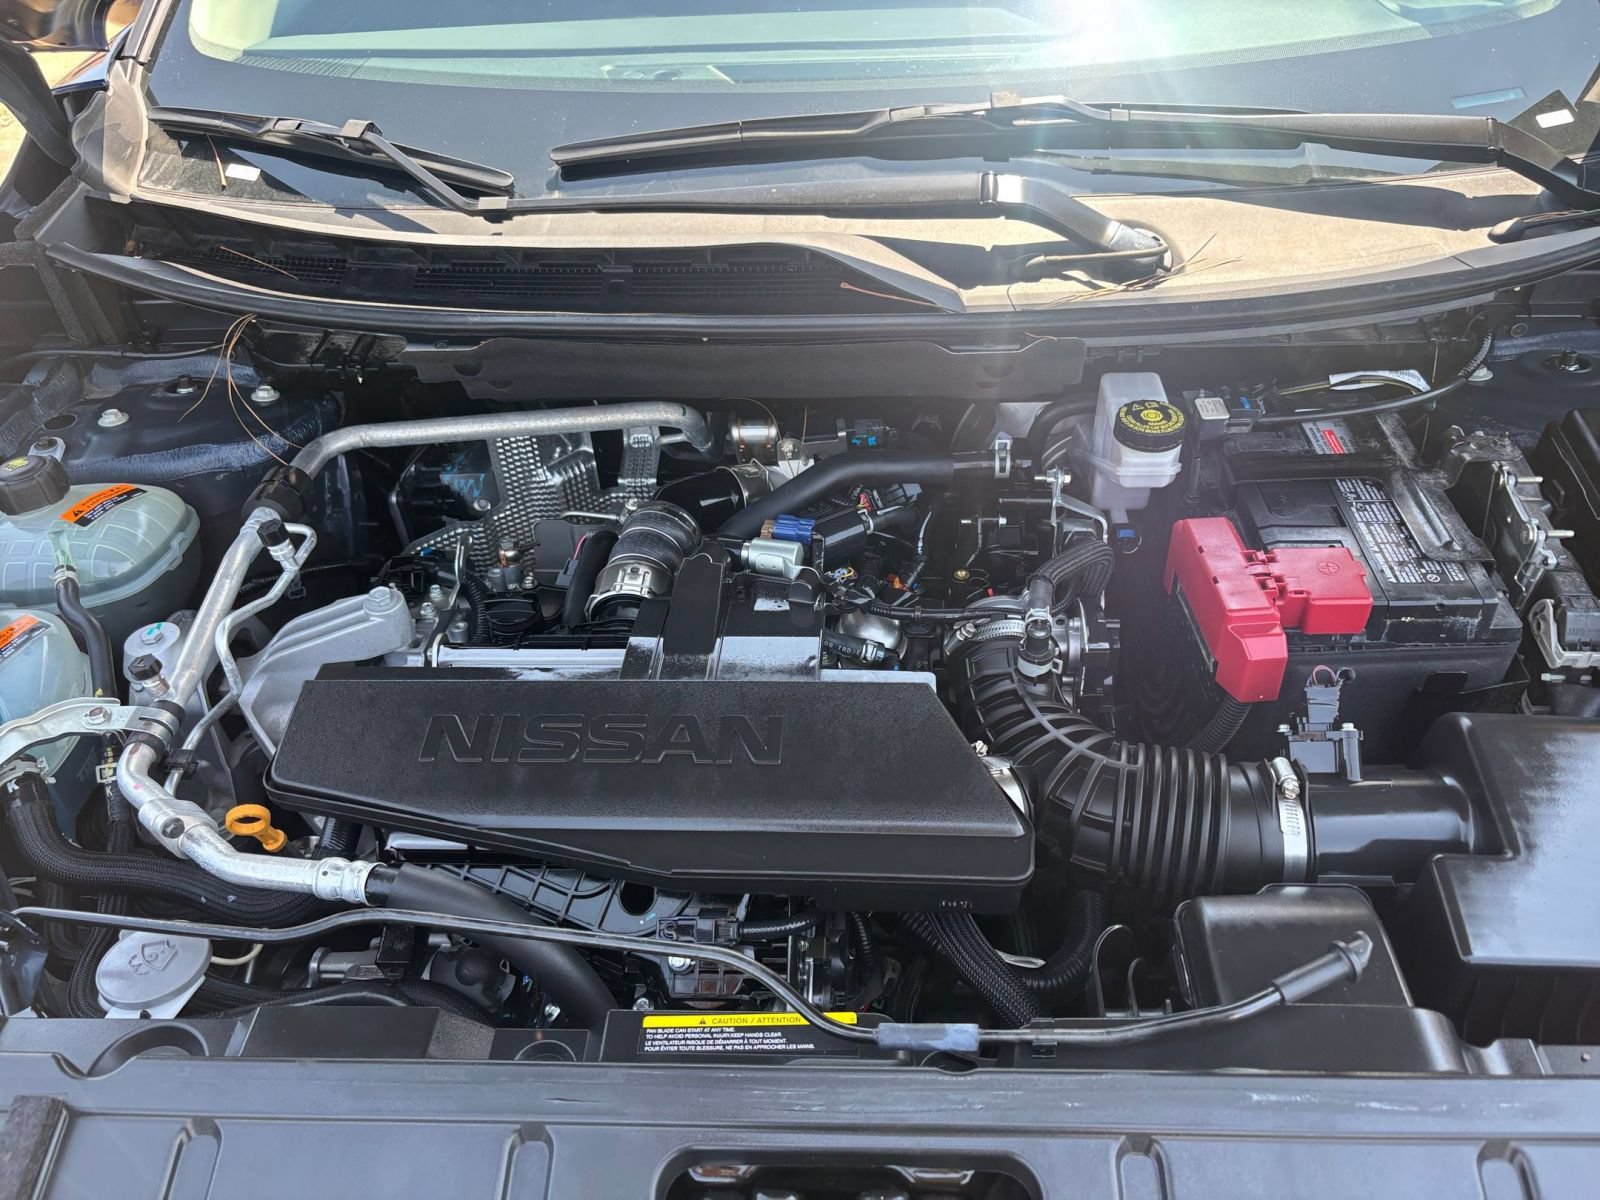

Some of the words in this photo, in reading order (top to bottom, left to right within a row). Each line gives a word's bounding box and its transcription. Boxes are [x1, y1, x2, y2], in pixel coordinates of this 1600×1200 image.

[417, 713, 785, 765] NISSAN
[6, 779, 20, 793] K
[711, 1017, 748, 1025] CAUTION
[757, 1016, 801, 1024] ATTENTION
